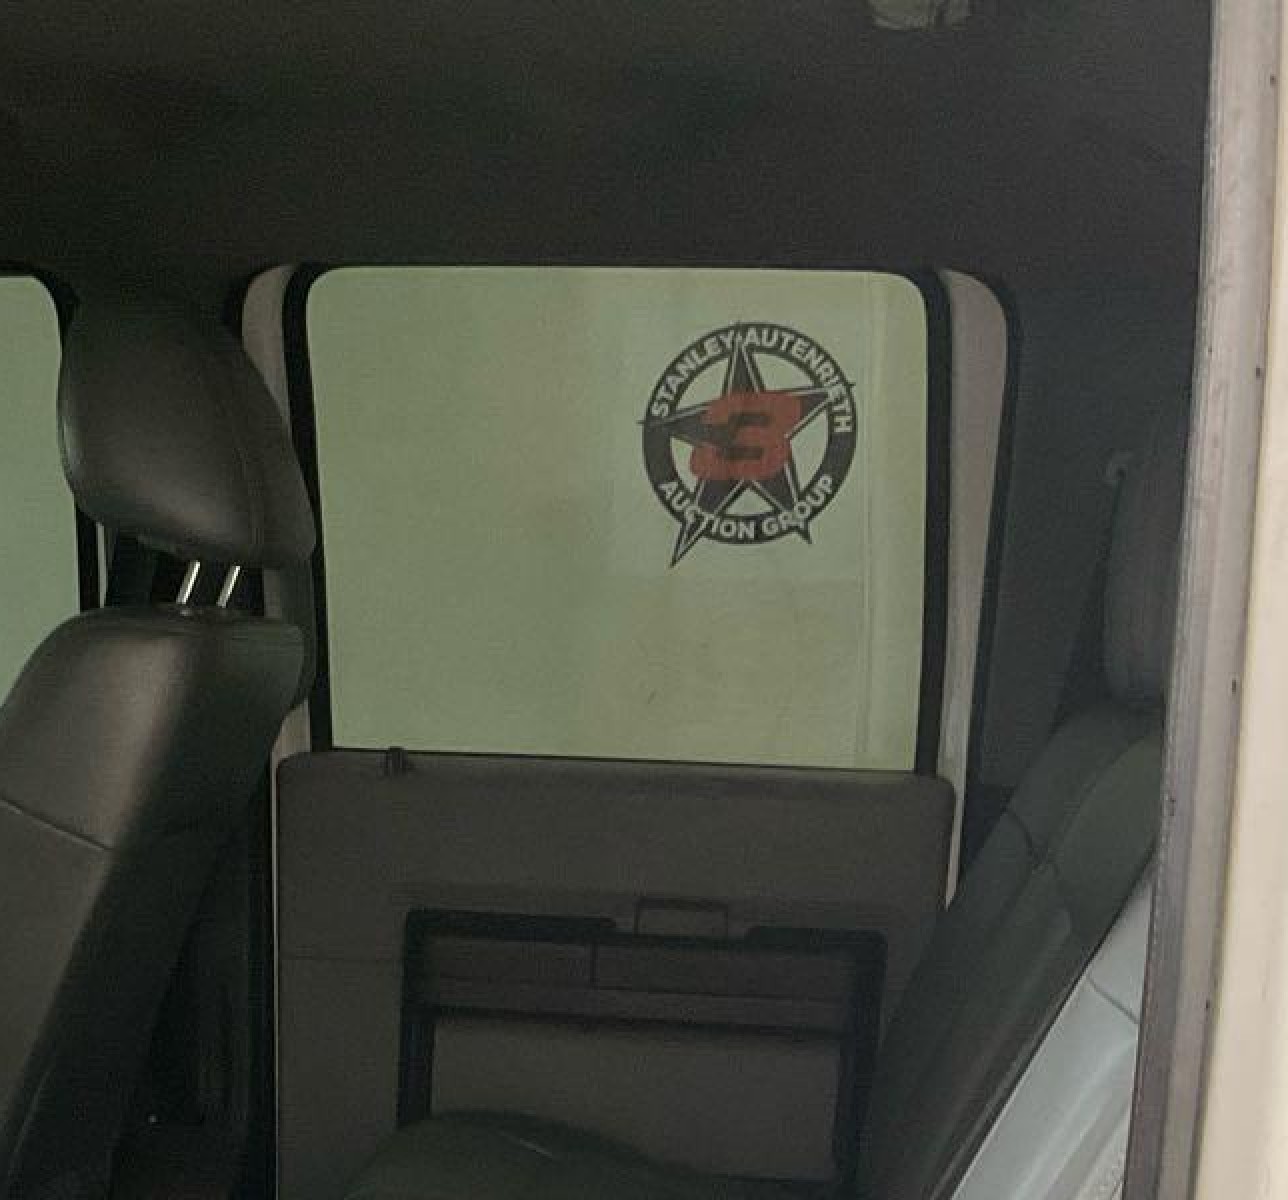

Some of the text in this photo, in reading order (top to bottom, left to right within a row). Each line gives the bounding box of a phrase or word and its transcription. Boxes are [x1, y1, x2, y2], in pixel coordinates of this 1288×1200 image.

[651, 327, 852, 433] STANLEY AUTENRIETH
[658, 474, 833, 540] AUCTION GROUP
